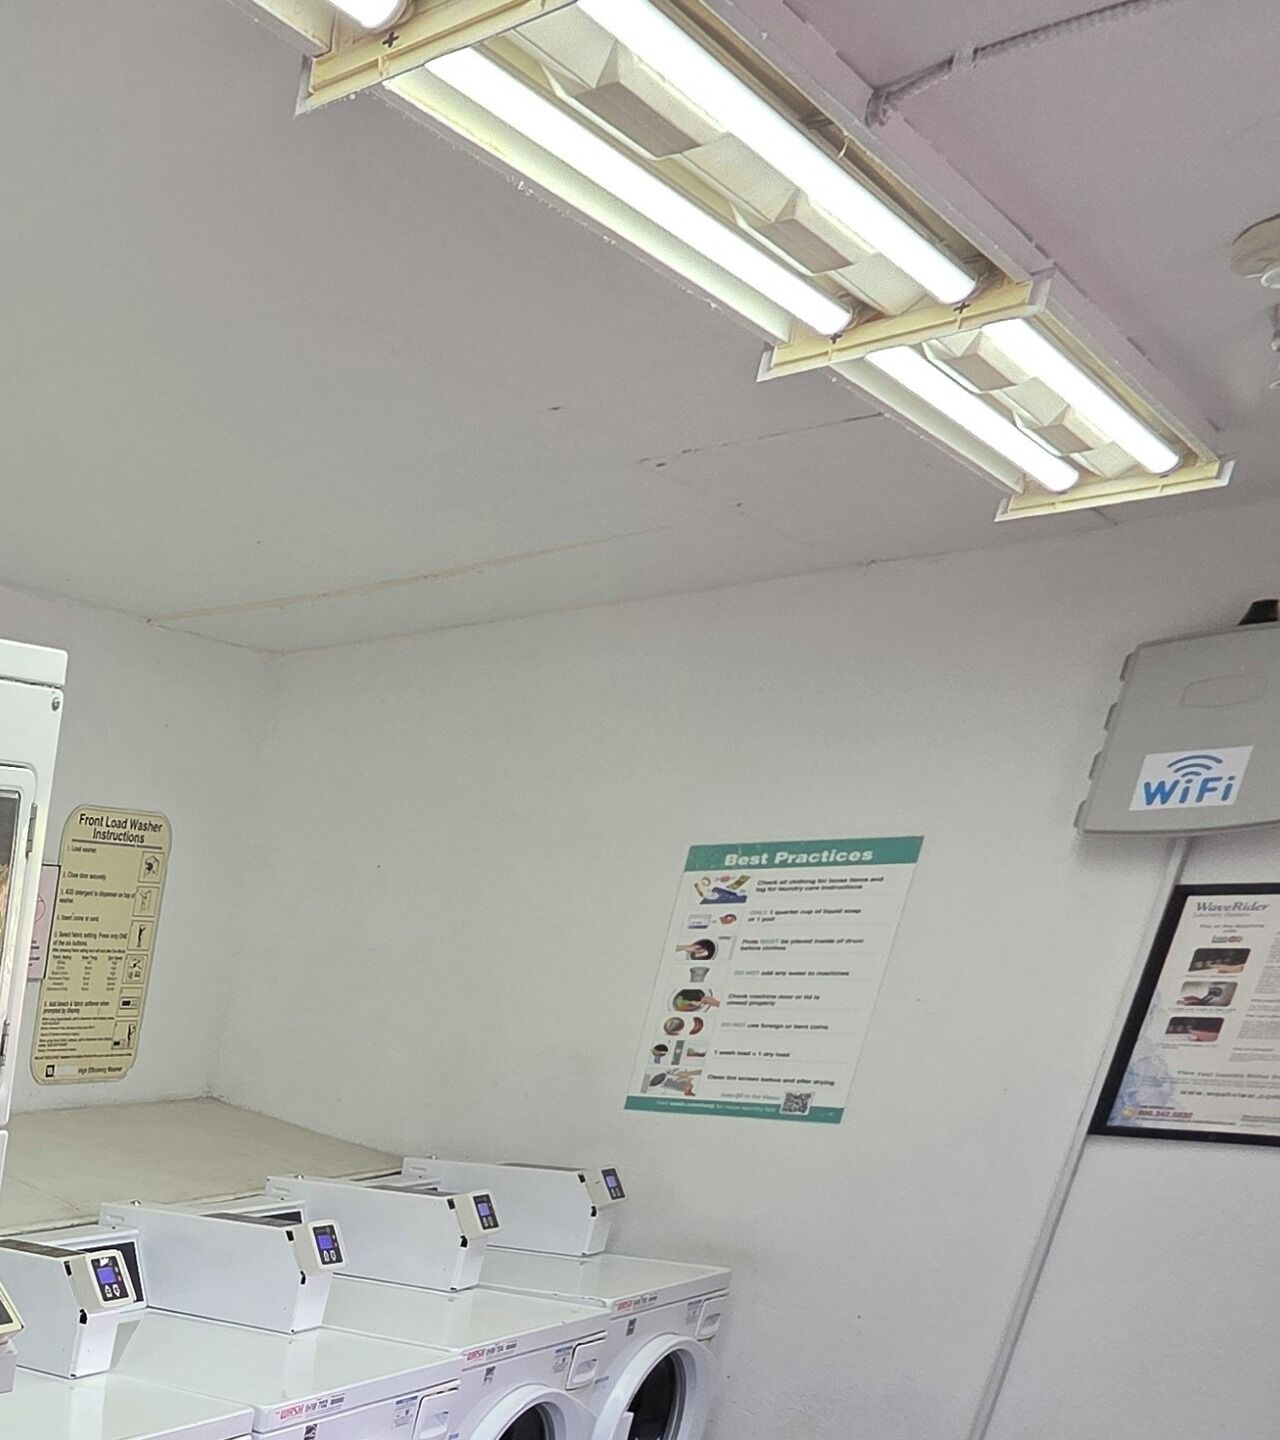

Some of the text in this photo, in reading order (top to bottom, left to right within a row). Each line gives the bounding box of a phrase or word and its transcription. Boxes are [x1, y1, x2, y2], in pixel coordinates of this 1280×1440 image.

[1144, 776, 1235, 806] WiFi
[79, 814, 162, 832] Front Load Washer
[93, 828, 144, 843] Instructions
[725, 850, 873, 866] Best Practices
[1197, 902, 1270, 911] WaveRider
[280, 1404, 304, 1419] WASH
